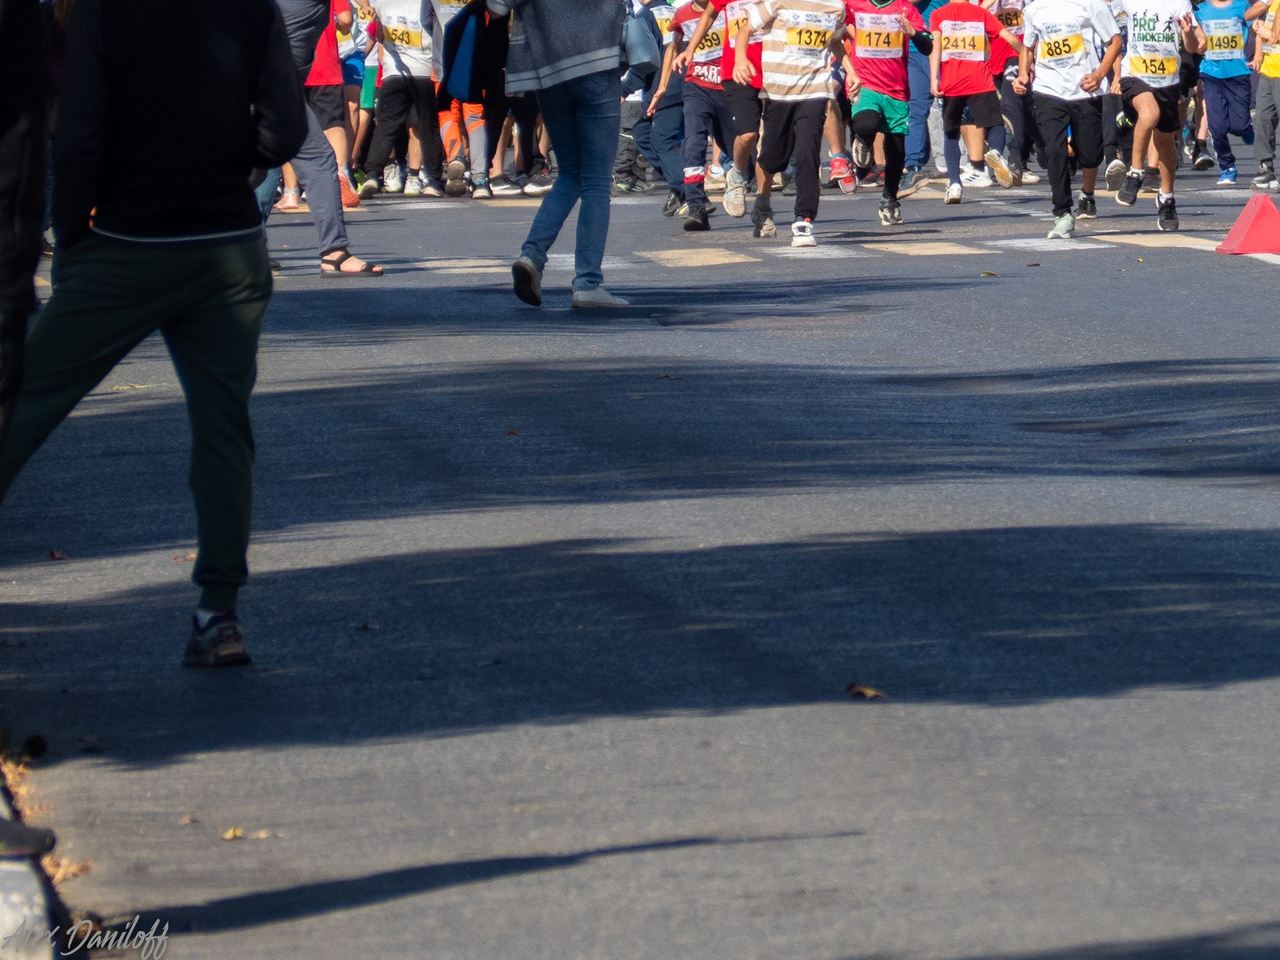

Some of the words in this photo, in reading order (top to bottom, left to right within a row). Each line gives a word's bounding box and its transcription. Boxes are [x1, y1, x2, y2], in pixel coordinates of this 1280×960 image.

[1132, 17, 1155, 32] PRO
[391, 29, 411, 44] 543
[797, 29, 827, 46] 1374
[866, 31, 891, 47] 174
[943, 36, 976, 50] 2414
[1210, 35, 1238, 50] 1495
[1047, 38, 1072, 57] 885
[1142, 59, 1166, 74] 154
